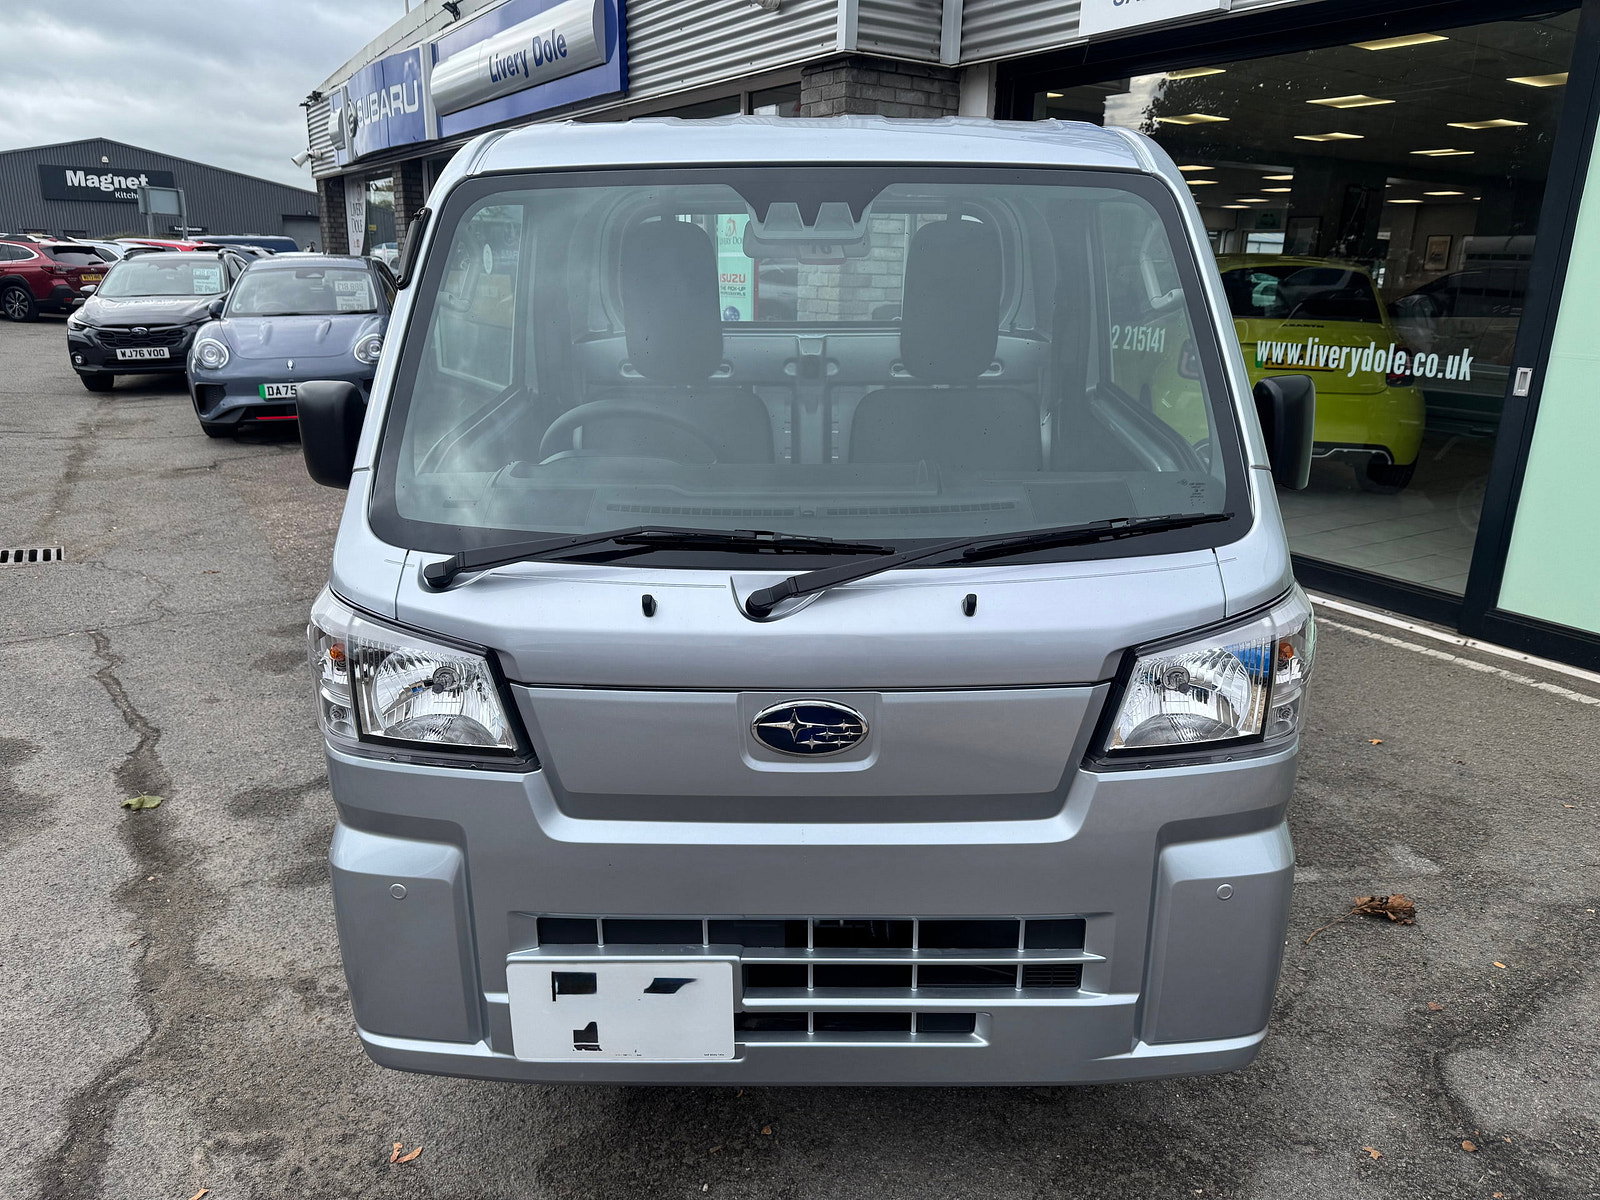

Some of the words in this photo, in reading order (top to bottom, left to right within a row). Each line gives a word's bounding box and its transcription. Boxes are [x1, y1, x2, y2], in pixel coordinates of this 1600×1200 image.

[488, 49, 529, 83] Livery
[532, 28, 568, 67] Dole
[356, 79, 419, 129] SUBARU
[65, 169, 149, 192] Magnet
[120, 349, 145, 358] WJ76
[1123, 325, 1166, 353] 215141
[1256, 337, 1474, 382] www.liverydole.co.uk
